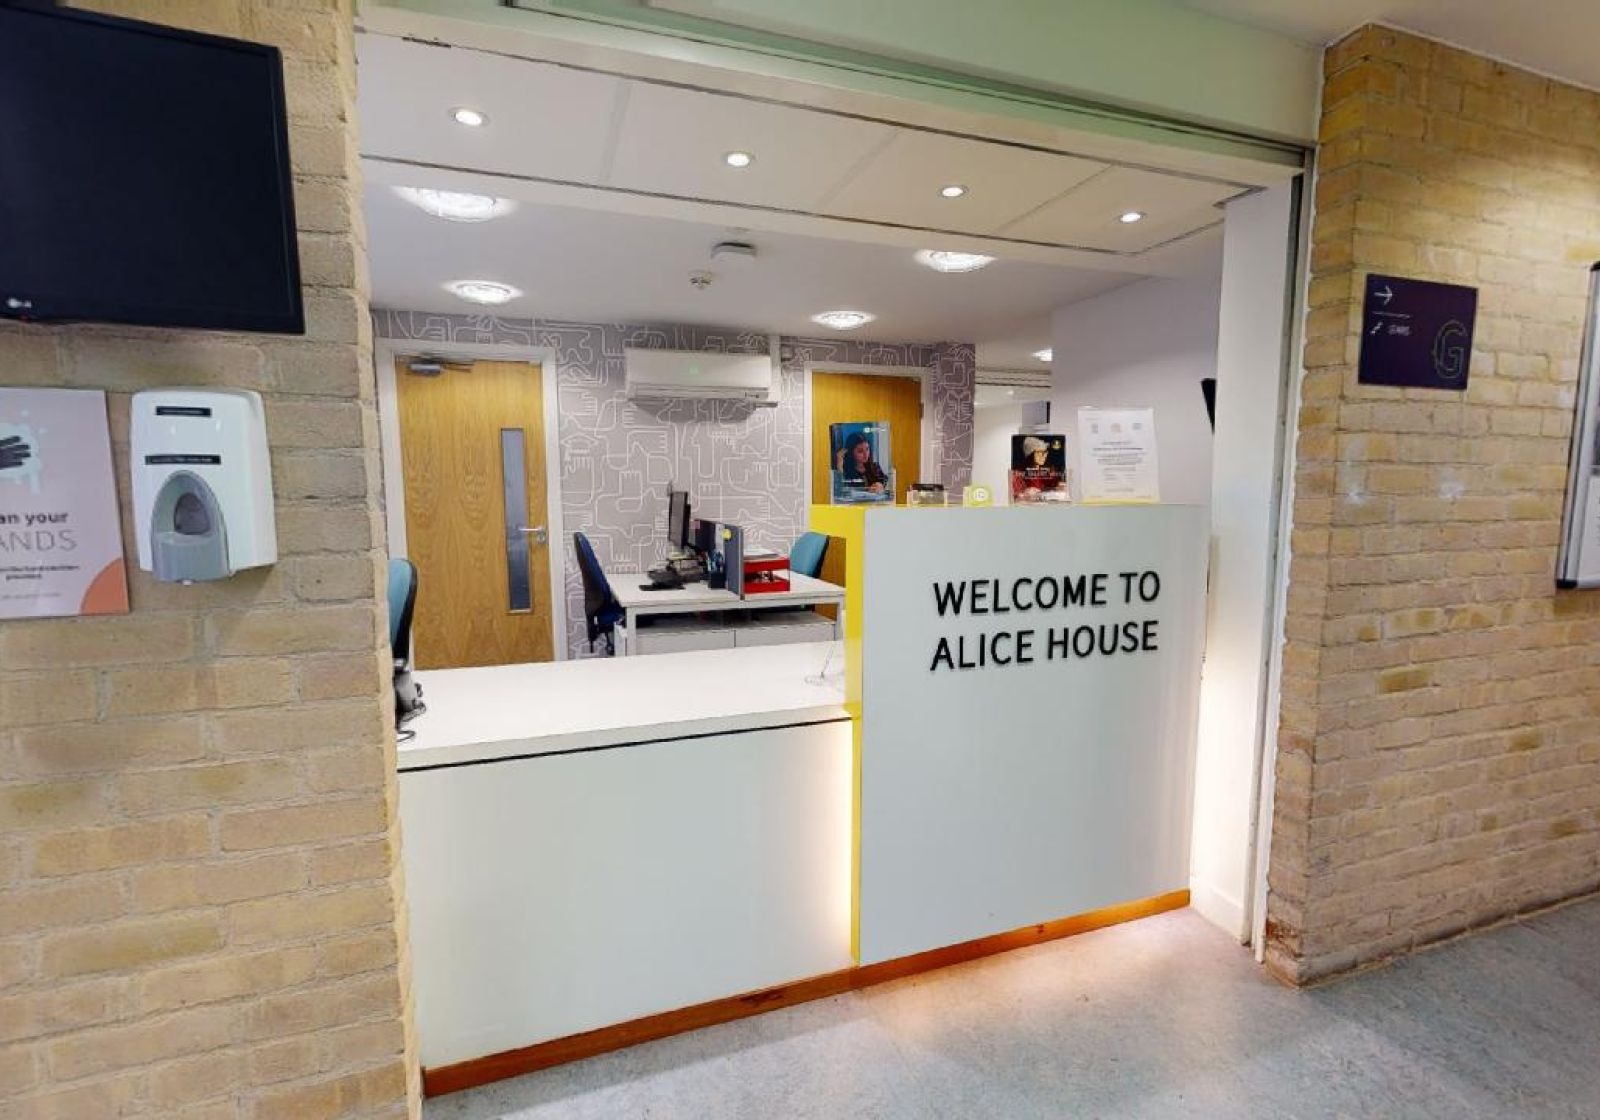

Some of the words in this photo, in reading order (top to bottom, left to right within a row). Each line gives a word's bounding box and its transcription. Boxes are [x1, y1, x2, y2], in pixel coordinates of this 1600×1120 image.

[25, 512, 68, 527] your
[933, 573, 1109, 616] WELCOME
[1119, 570, 1161, 604] TO
[930, 629, 1035, 671] ALICE
[1047, 620, 1160, 660] HOUSE
